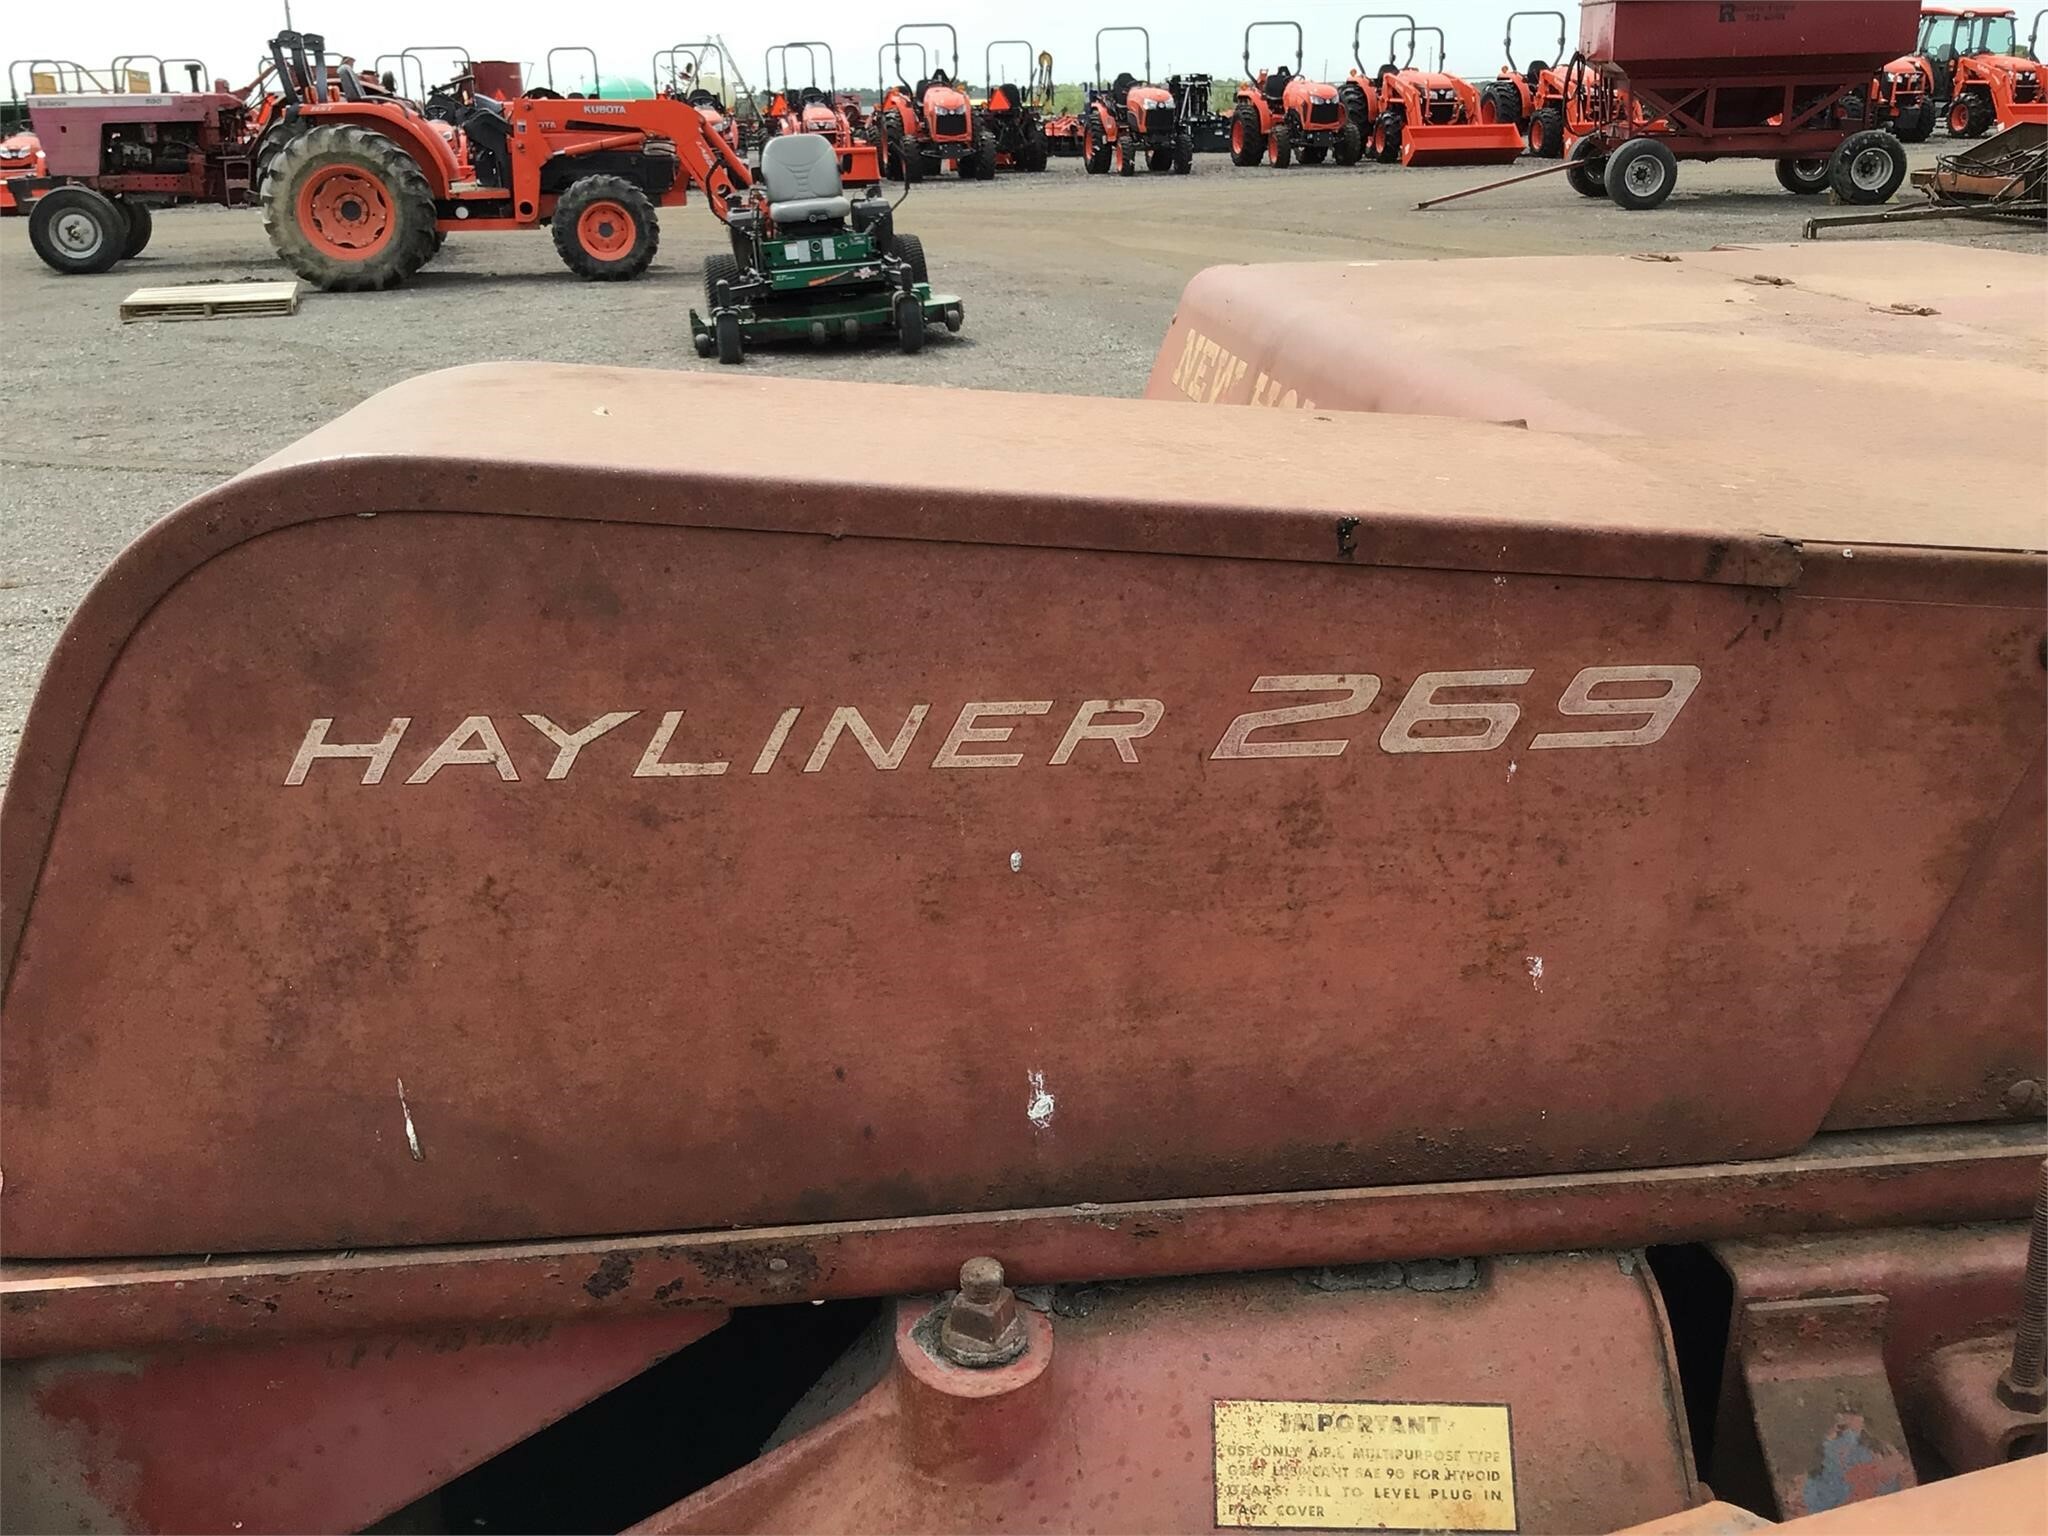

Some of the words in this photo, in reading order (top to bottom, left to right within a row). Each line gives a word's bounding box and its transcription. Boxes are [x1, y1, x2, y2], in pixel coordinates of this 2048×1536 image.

[583, 105, 626, 114] KUBOTA
[1171, 328, 1249, 405] NEW
[283, 698, 1166, 787] HAYLINER
[1209, 664, 1702, 760] 269
[1279, 1412, 1442, 1435] IMPORTANT
[1227, 1444, 1255, 1458] USE
[1260, 1445, 1300, 1459] ONLY
[1352, 1447, 1461, 1462] MULTIPURPOSE
[1467, 1450, 1501, 1463] TYPE
[1386, 1468, 1405, 1480] 90
[1413, 1469, 1440, 1481] FOR
[1446, 1470, 1501, 1483] HYPOID
[1342, 1486, 1363, 1498] TO
[1373, 1487, 1421, 1500] LEVEL
[1430, 1488, 1474, 1501] PLUG
[1227, 1503, 1269, 1517] BACK
[1276, 1504, 1326, 1518] COVER
